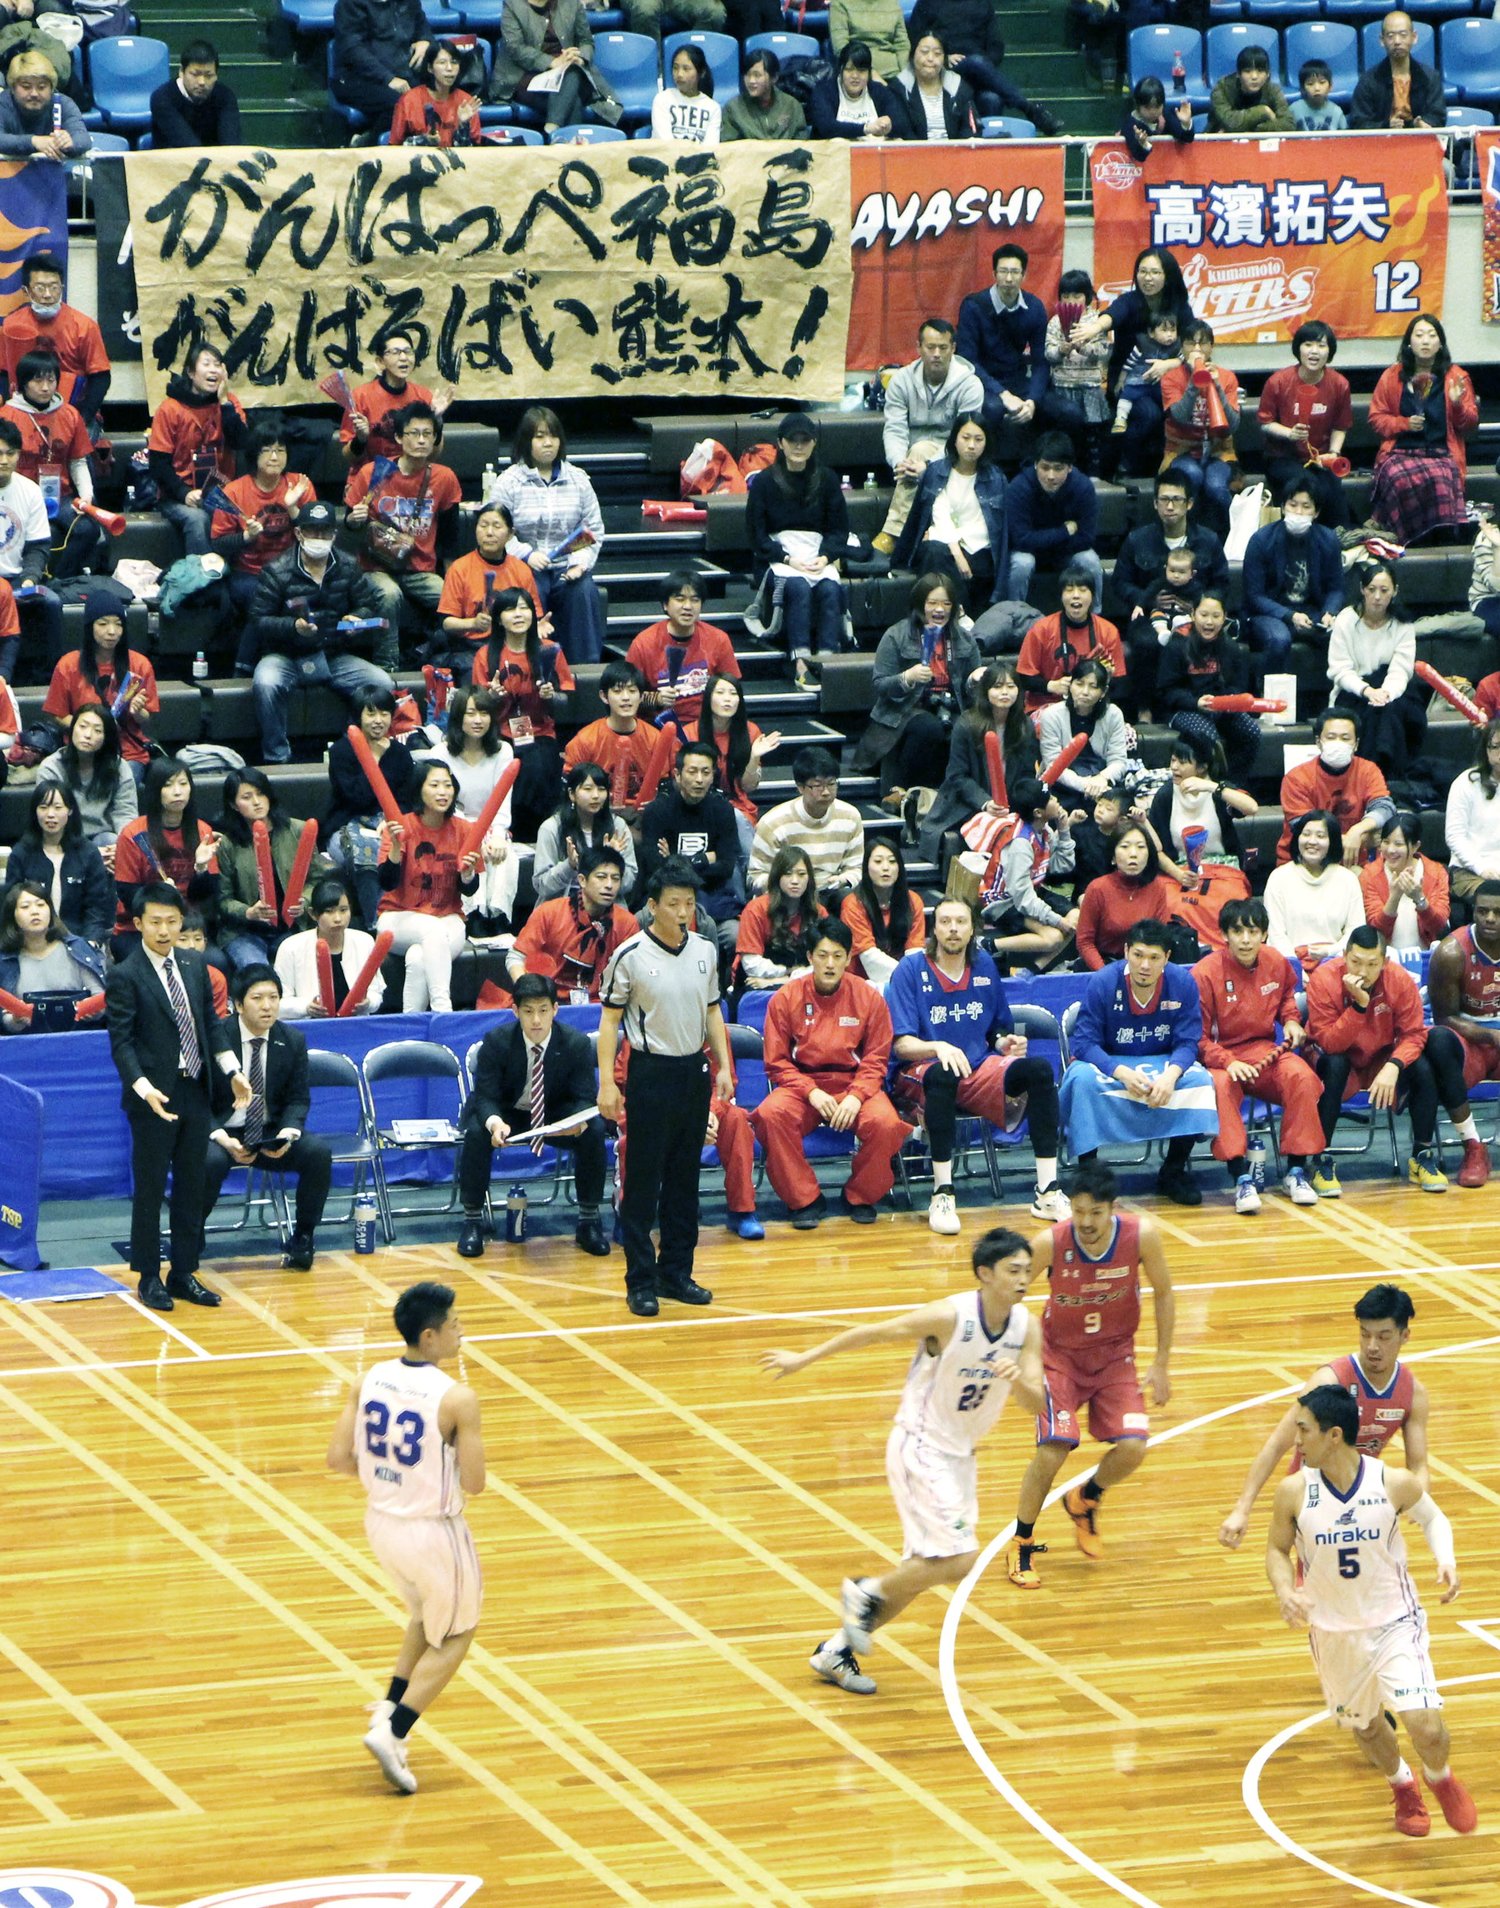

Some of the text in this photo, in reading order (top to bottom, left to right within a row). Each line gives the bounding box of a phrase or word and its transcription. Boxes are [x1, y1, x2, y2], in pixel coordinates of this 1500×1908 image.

[669, 104, 710, 129] STEP
[145, 148, 836, 277] がんばっぺ福島
[1146, 177, 1390, 247] 高濱拓矢
[1208, 258, 1281, 283] kumamoto
[1373, 260, 1421, 312] 12
[930, 1001, 984, 1024] 桜十字
[1, 1205, 22, 1229] TSP
[1084, 1312, 1101, 1334] 9
[364, 1400, 425, 1467] 23
[1315, 1527, 1380, 1545] niraku
[1338, 1547, 1360, 1579] 5
